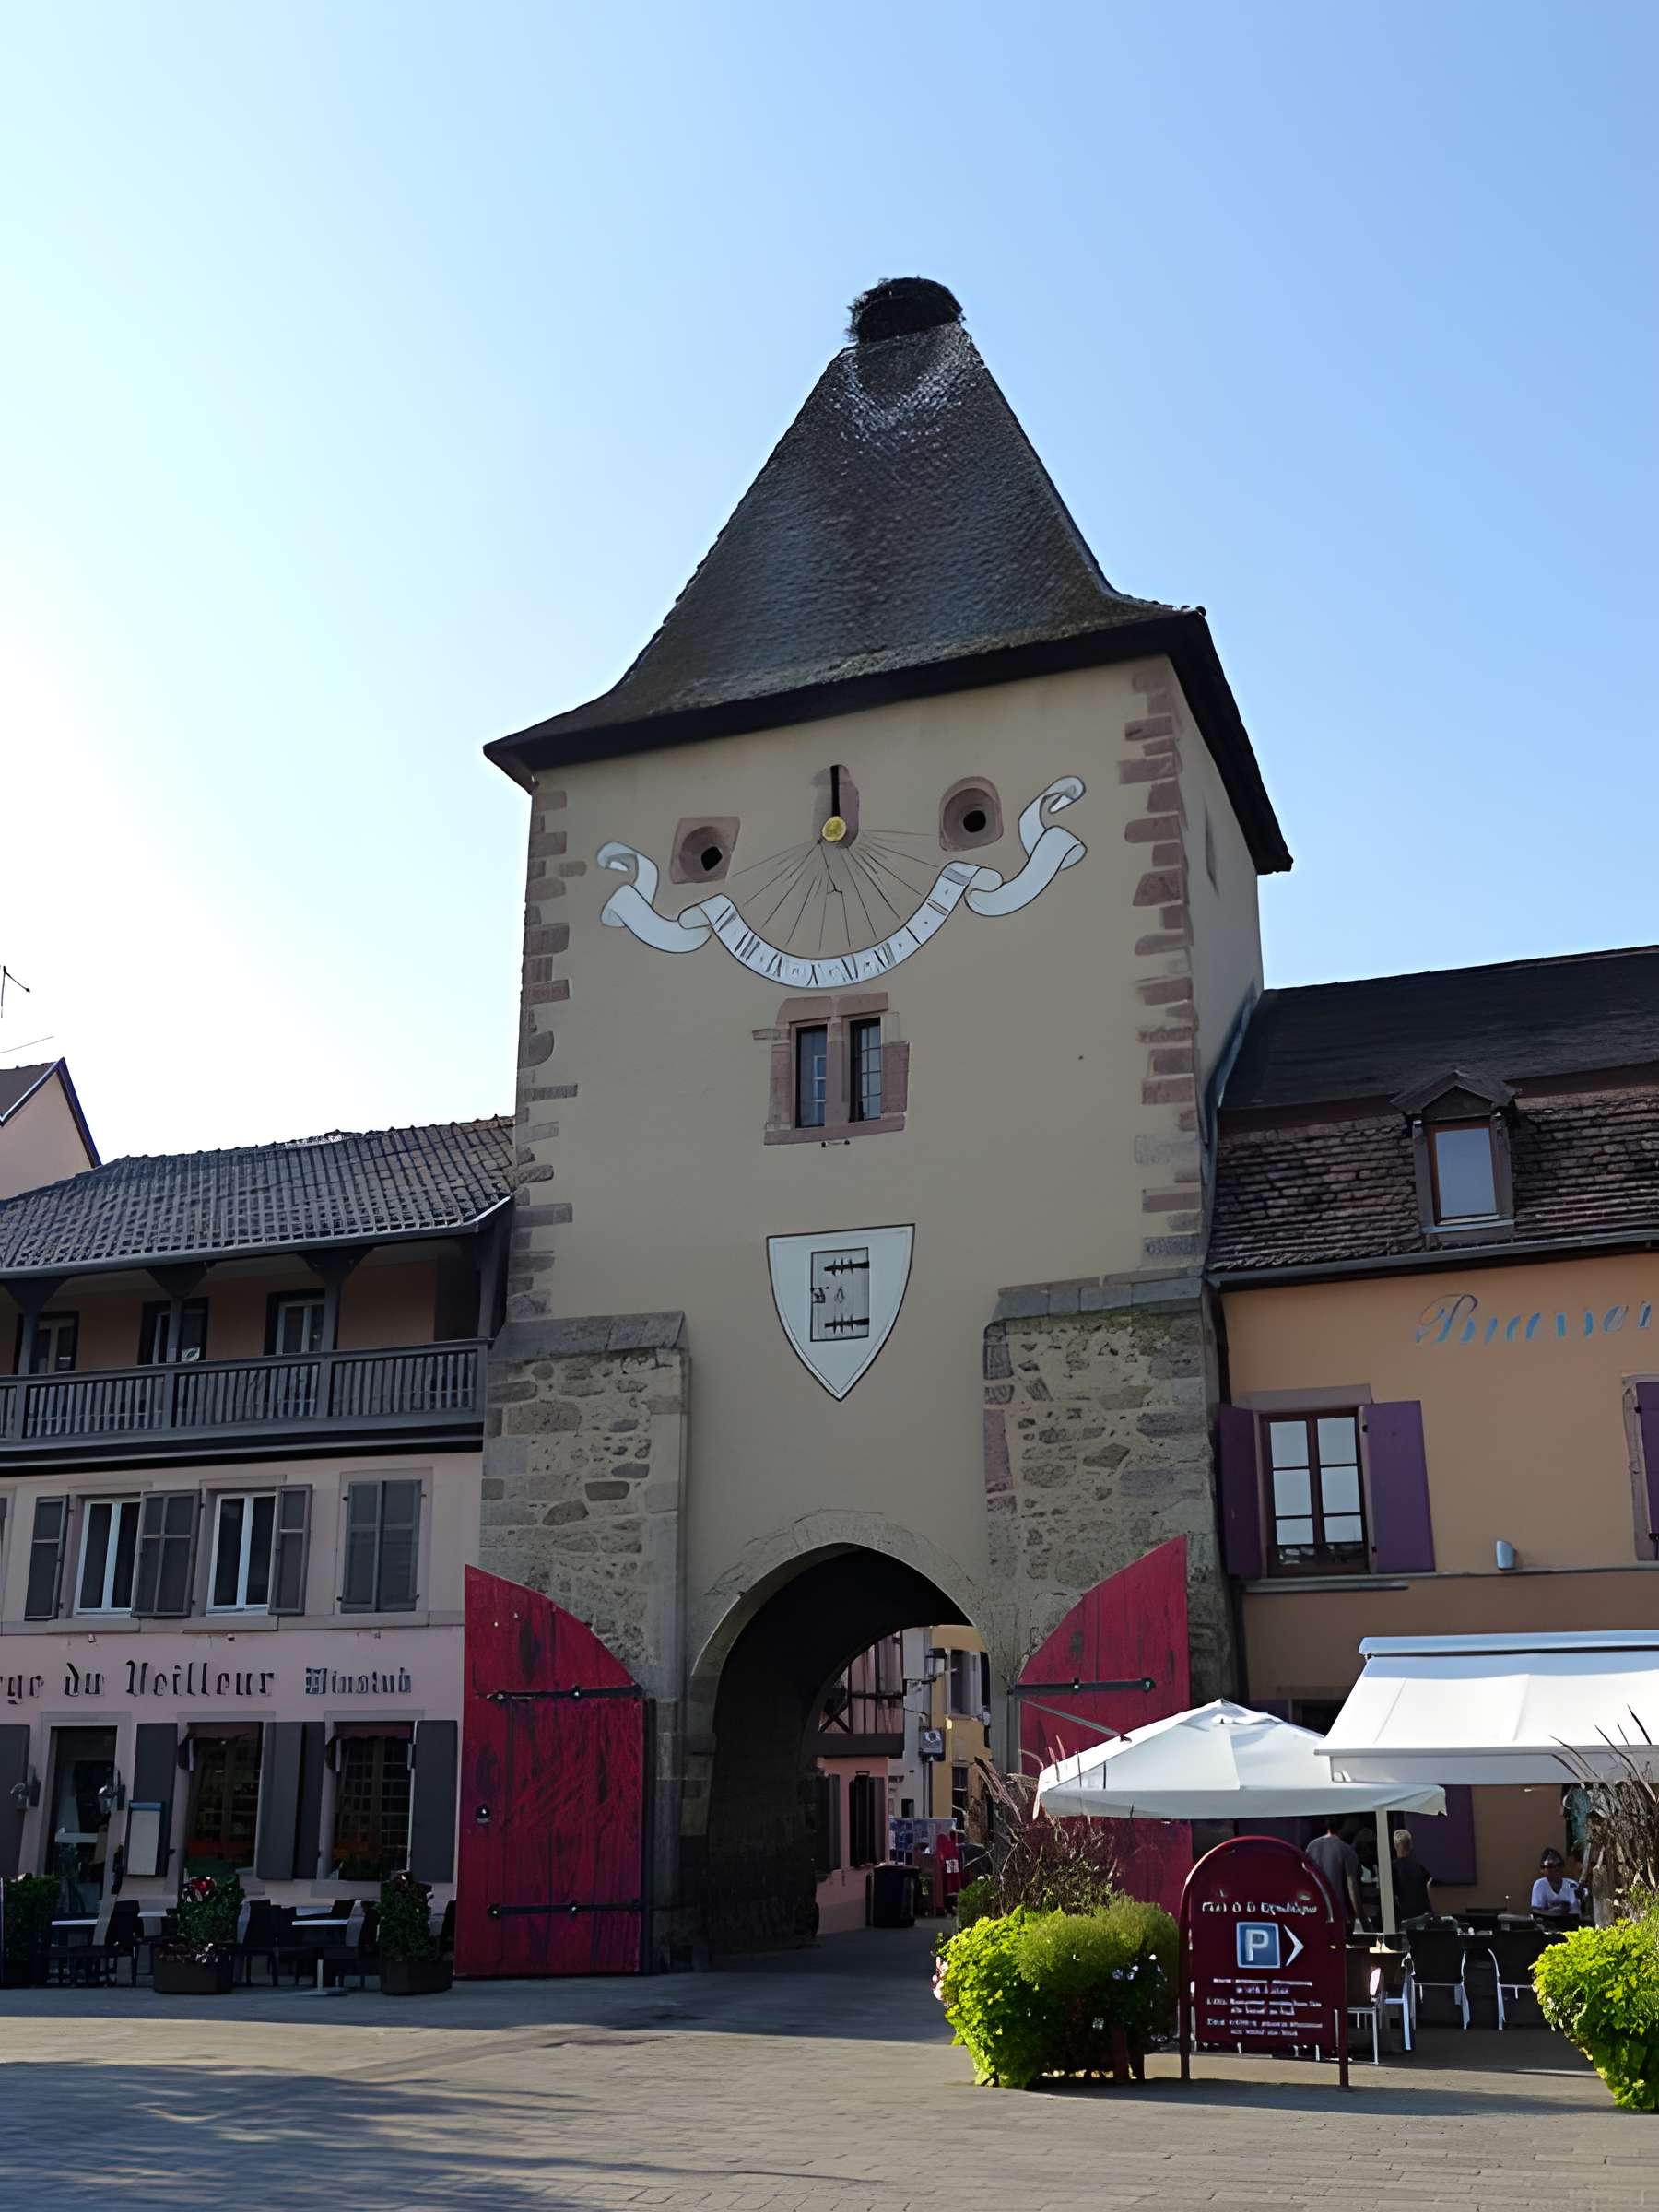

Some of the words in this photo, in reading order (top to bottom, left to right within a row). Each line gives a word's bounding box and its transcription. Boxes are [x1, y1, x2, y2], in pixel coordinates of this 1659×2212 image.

[65, 1662, 104, 1697] du
[125, 1659, 275, 1697] Veilleur
[1245, 1928, 1269, 1962] P
